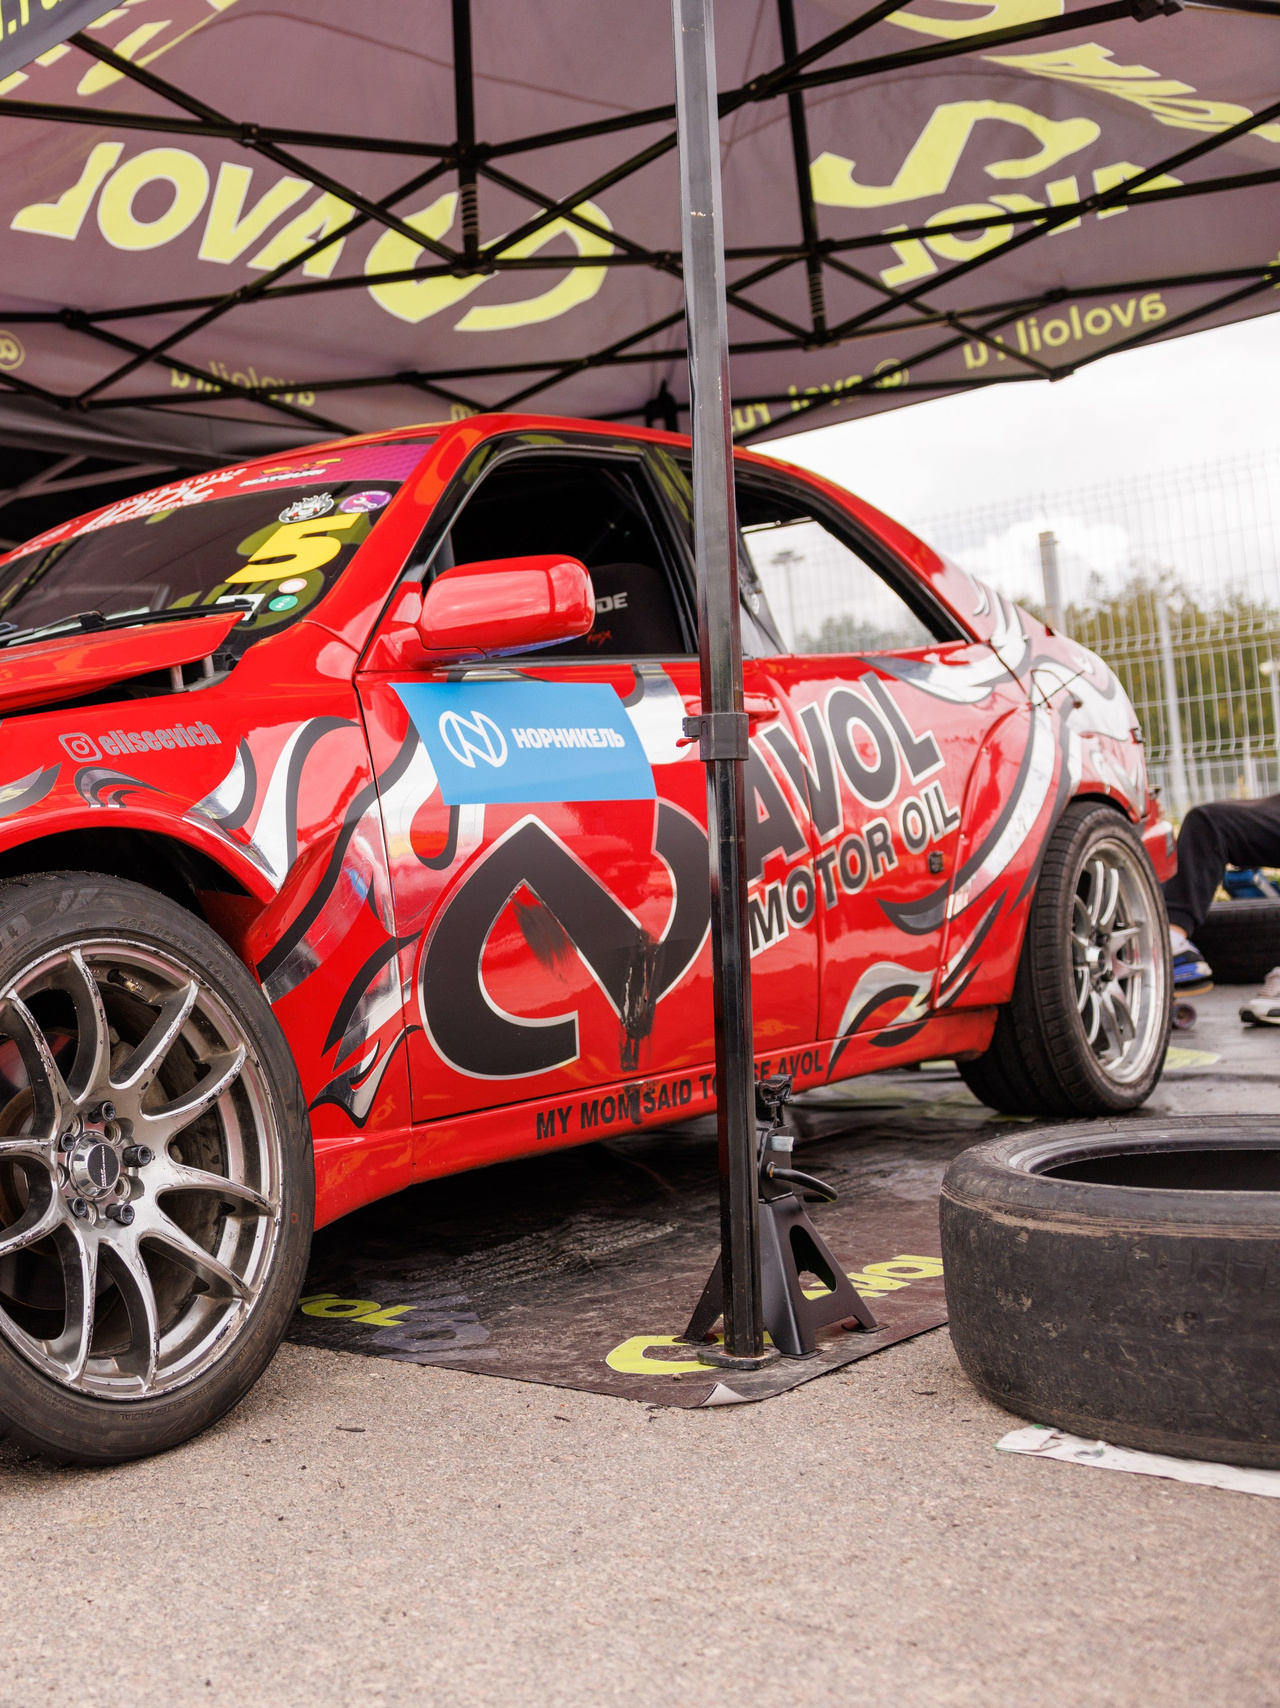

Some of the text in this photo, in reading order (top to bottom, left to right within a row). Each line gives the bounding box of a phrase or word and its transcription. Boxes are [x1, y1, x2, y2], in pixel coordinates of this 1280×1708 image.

[224, 512, 362, 584] 5
[99, 720, 222, 756] eliseevich
[511, 728, 626, 748] НОРНИКЕЛЬ
[748, 670, 946, 886] AVOL
[748, 779, 962, 959] MOTOR OIL
[536, 1105, 573, 1140] MY
[580, 1090, 634, 1129] MOM
[642, 1080, 693, 1114] SAID
[777, 1050, 824, 1079] AVOL
